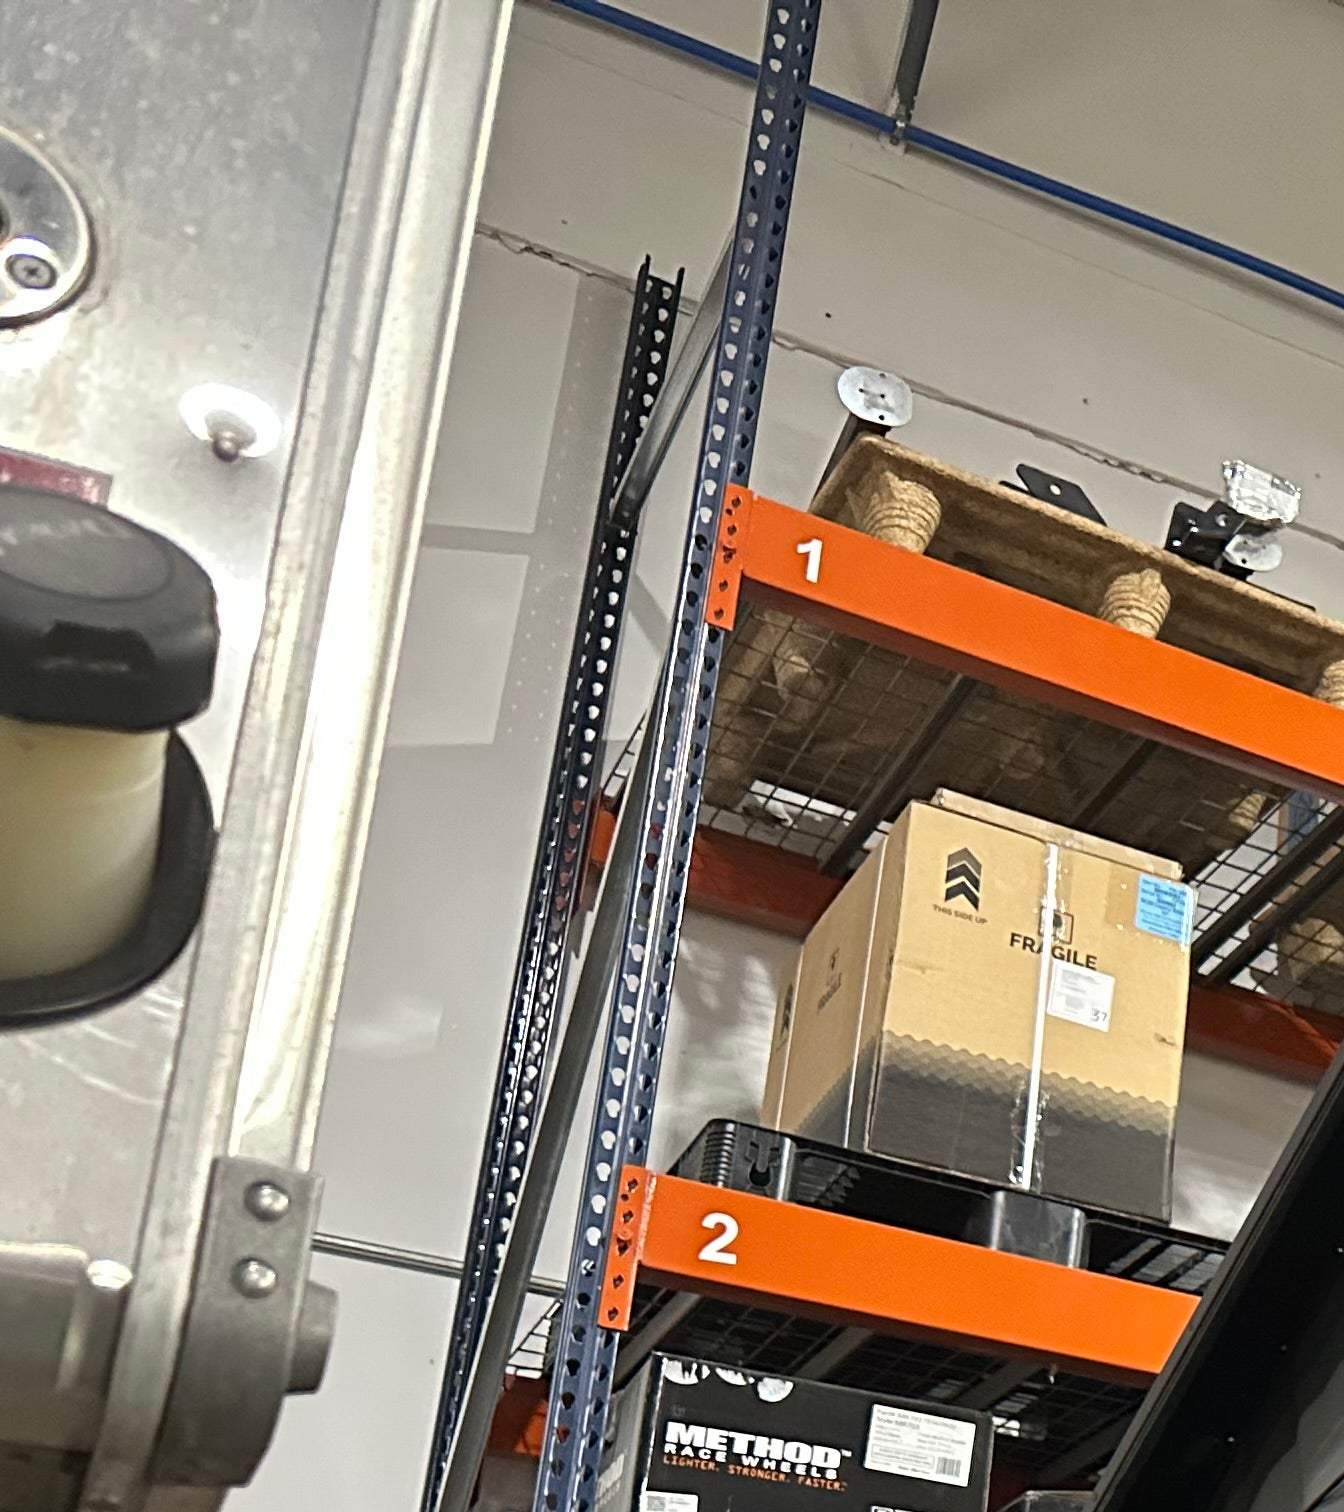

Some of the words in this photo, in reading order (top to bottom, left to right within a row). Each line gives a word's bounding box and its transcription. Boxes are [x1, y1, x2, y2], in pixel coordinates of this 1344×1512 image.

[797, 538, 823, 584] 1
[698, 1212, 739, 1265] 2
[664, 1444, 727, 1463] RACE
[741, 1455, 838, 1480] WHEELS
